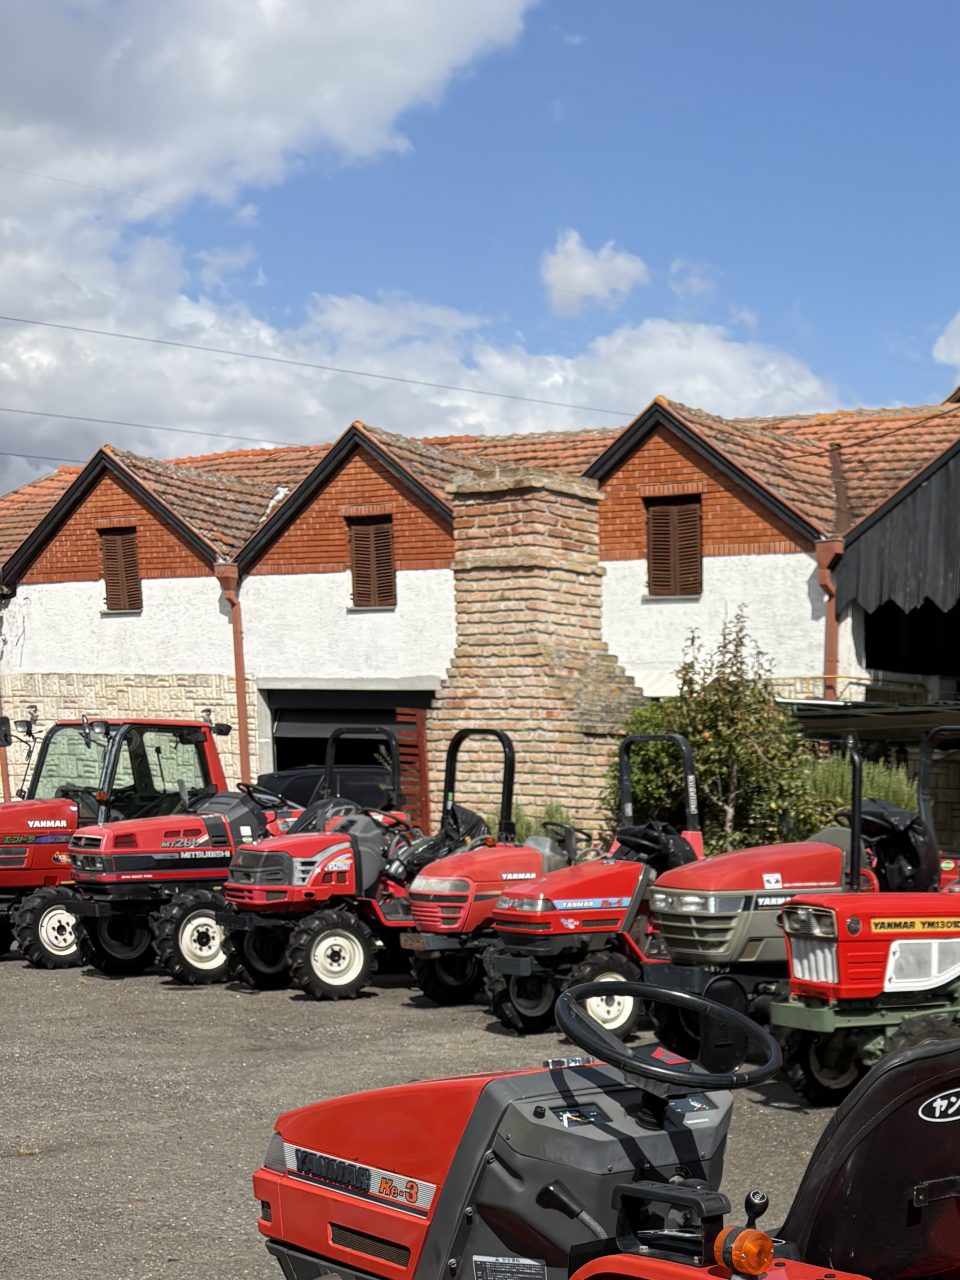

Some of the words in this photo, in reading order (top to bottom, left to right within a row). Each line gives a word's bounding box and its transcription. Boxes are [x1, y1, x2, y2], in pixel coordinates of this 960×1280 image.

[27, 820, 67, 828] YANMAR
[180, 850, 231, 859] MITSUBISHI
[501, 872, 536, 880] YANMAR
[757, 897, 792, 906] YANM
[873, 921, 916, 930] YANMAR
[295, 1148, 372, 1191] YANMAR
[378, 1177, 418, 1204] Ke-3
